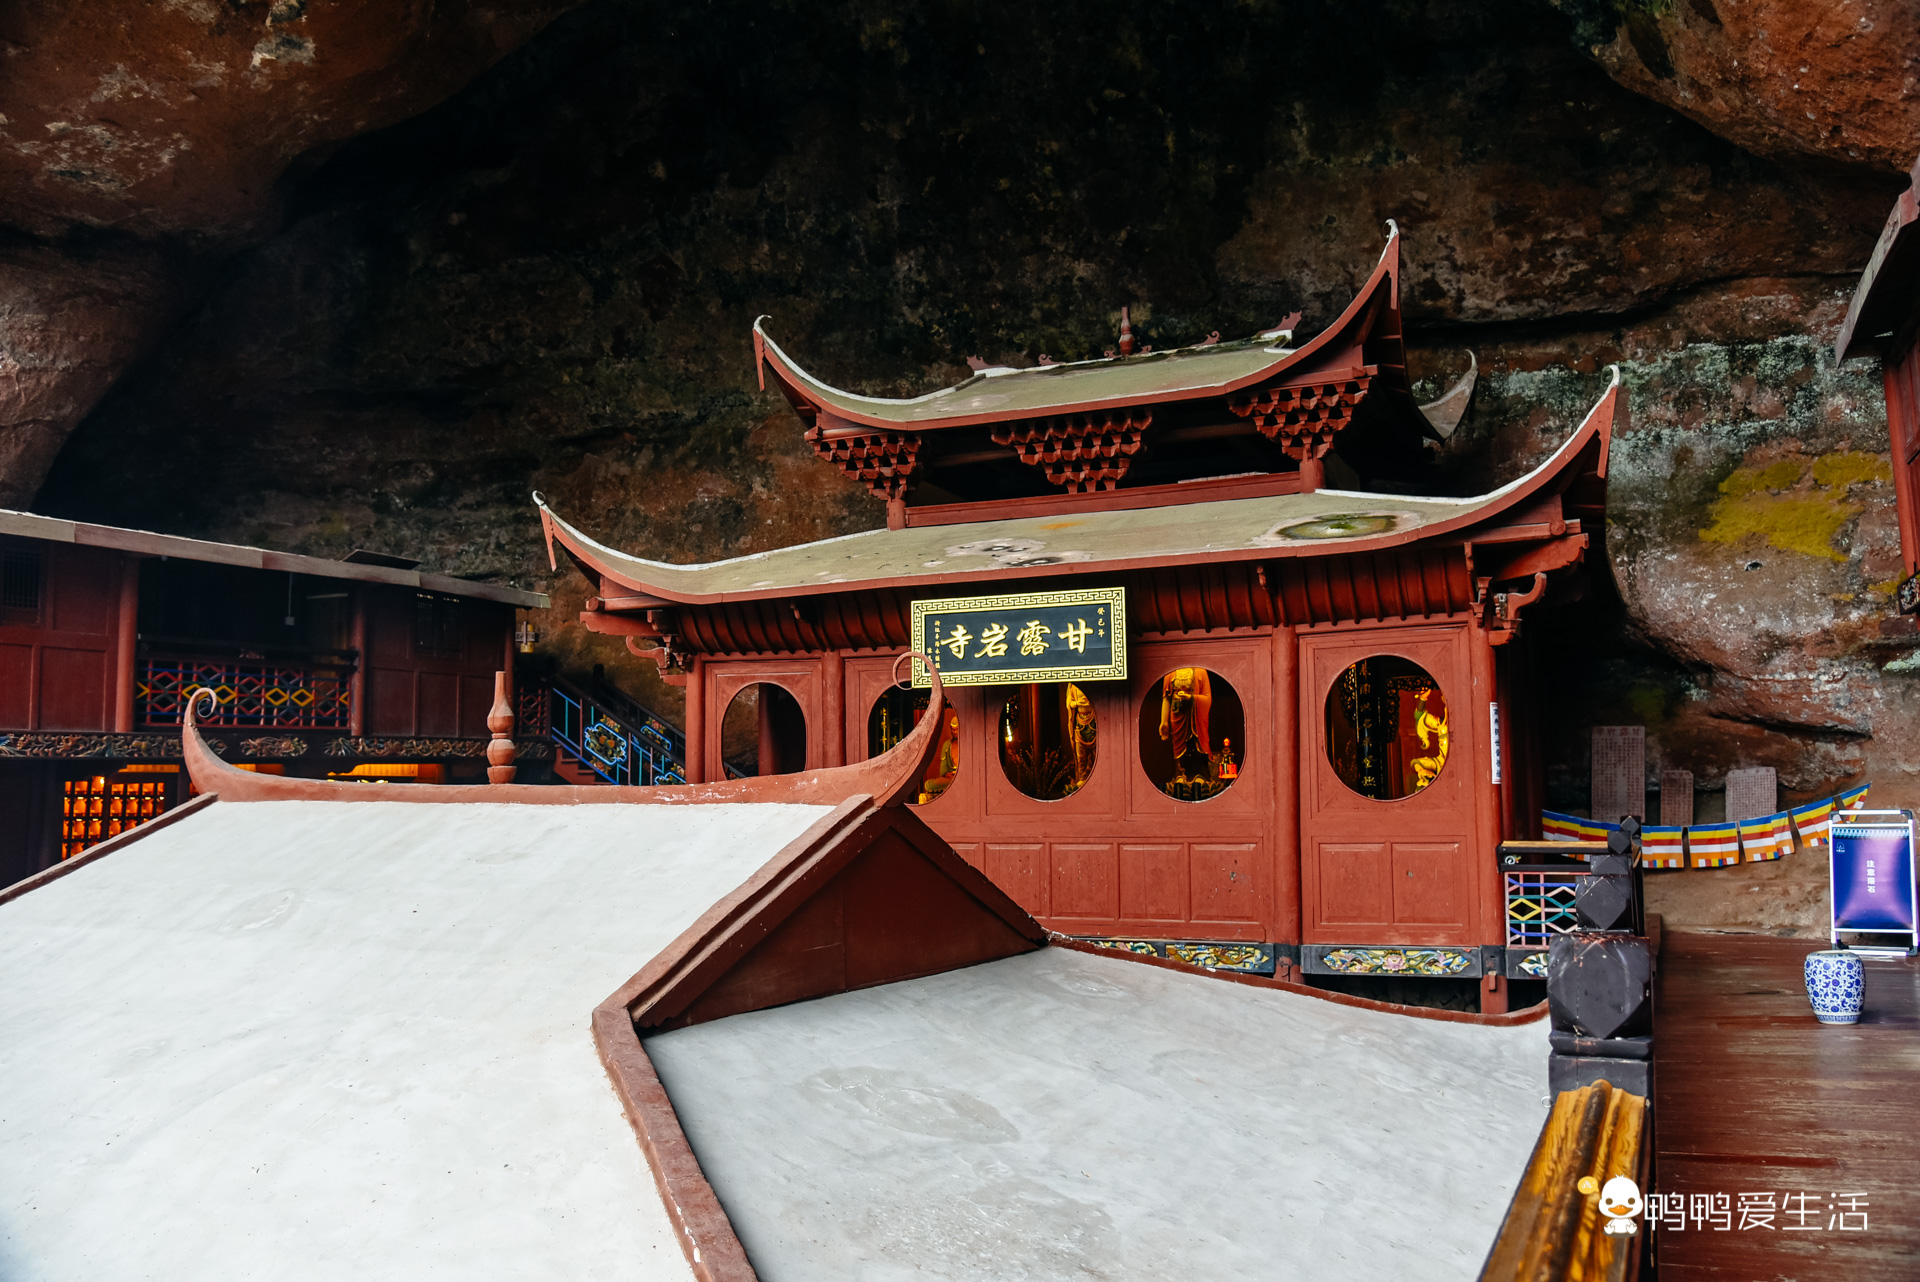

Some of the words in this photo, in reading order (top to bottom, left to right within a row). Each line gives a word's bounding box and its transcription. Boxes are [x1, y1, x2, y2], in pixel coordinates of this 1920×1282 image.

[940, 618, 1094, 660] 甘露岩寺
[1866, 859, 1877, 894] 注意落石
